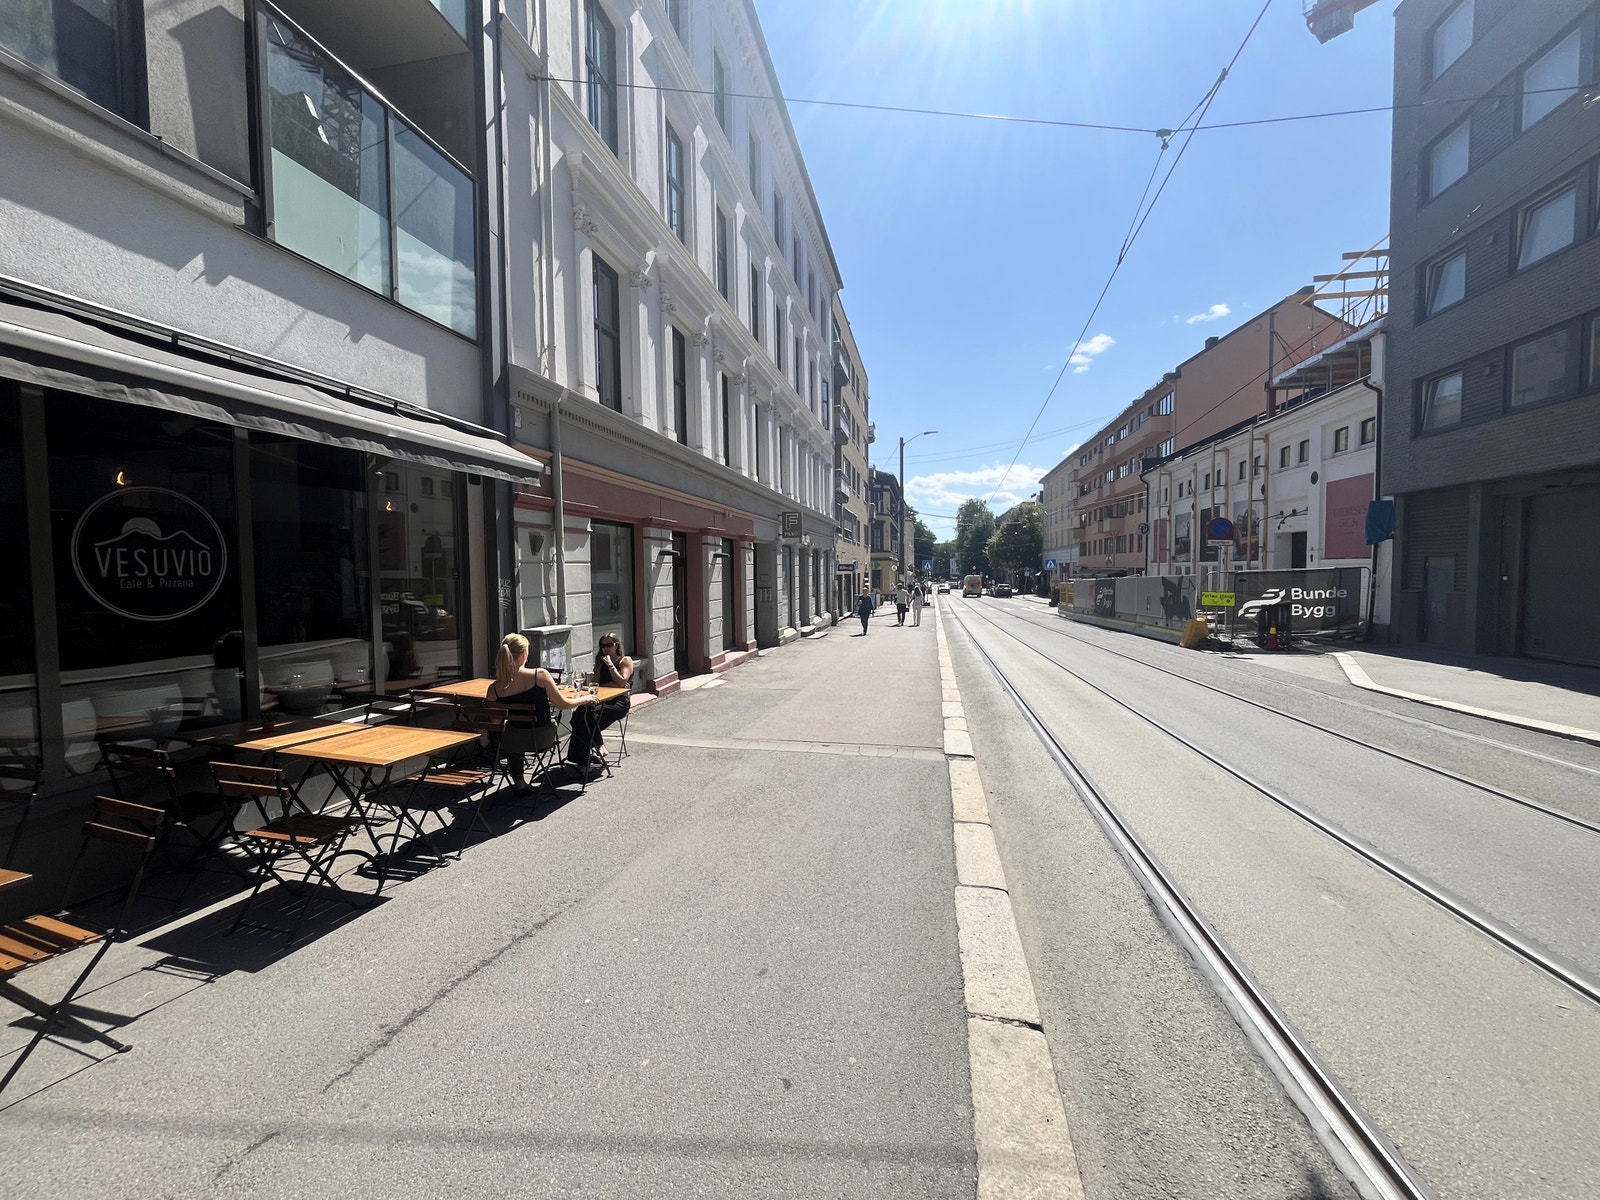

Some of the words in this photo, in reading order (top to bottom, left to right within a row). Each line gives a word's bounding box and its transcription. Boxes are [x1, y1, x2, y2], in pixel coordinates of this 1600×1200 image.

[786, 513, 799, 530] F
[94, 547, 212, 577] VESUVIO
[146, 578, 154, 588] &
[159, 578, 194, 588] Pizzeria
[1291, 586, 1348, 600] Bunde
[1291, 604, 1336, 619] Bygg
